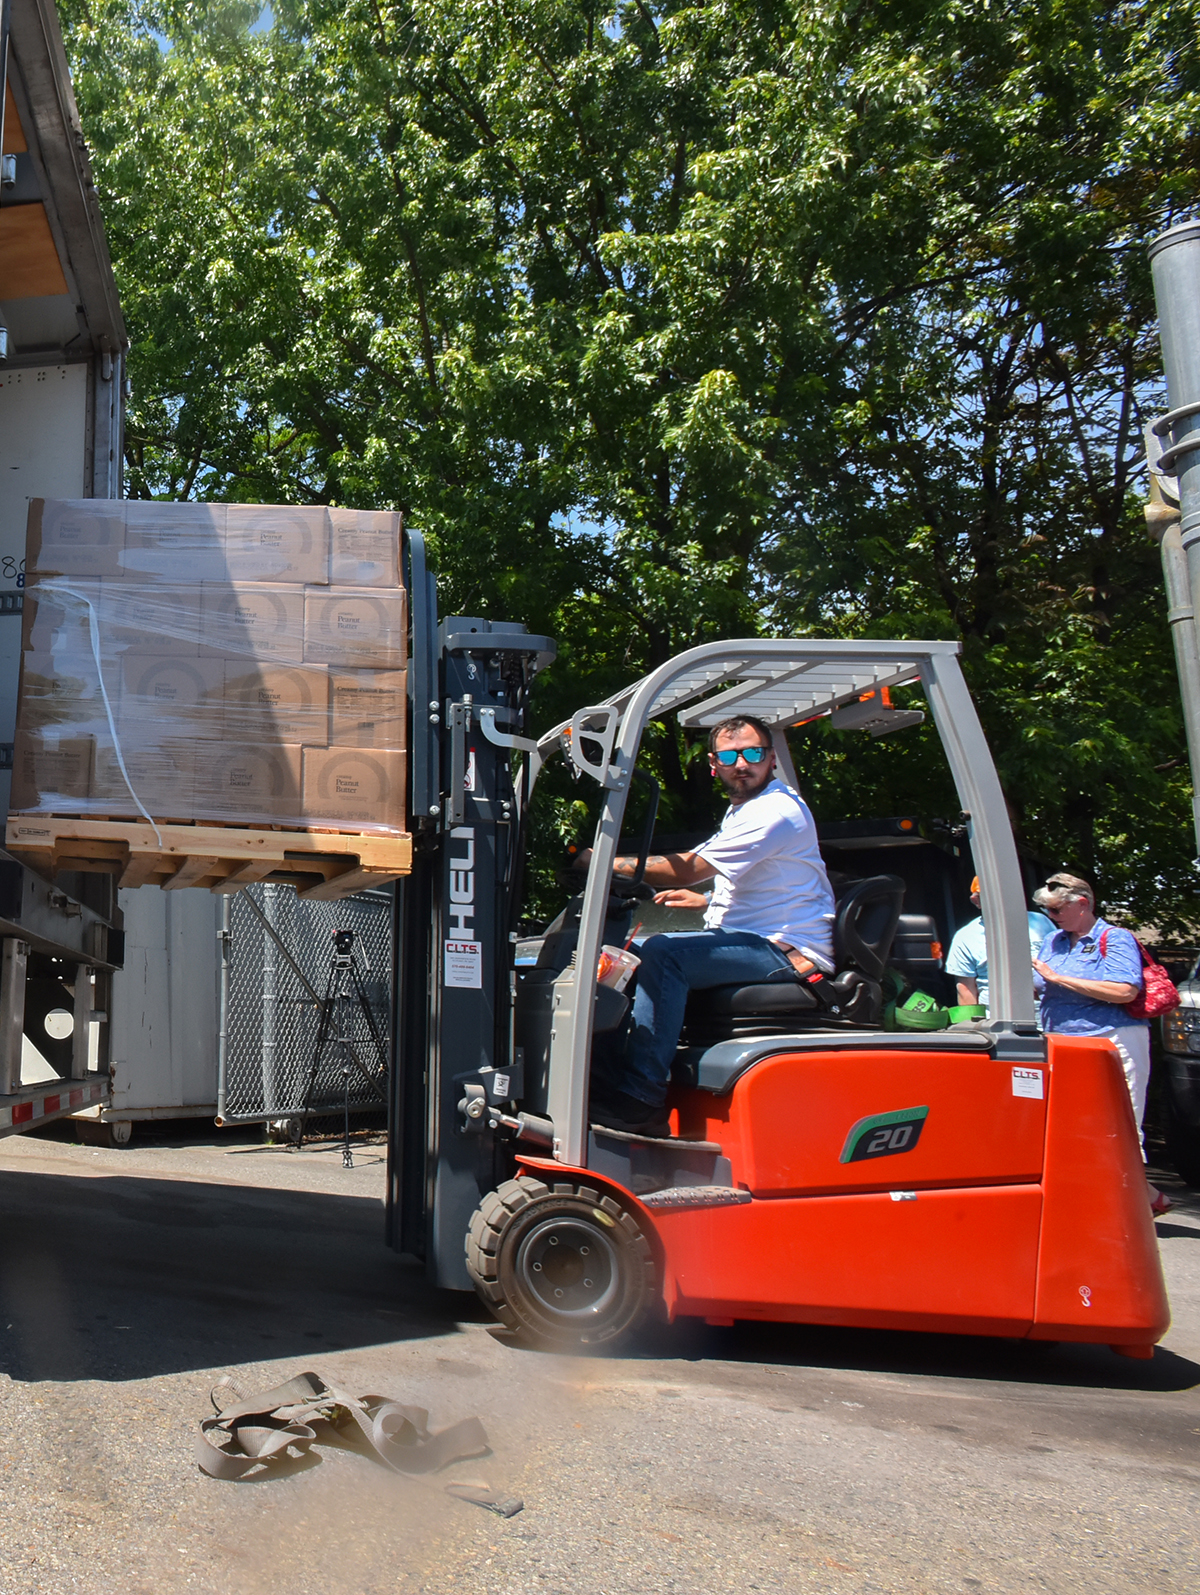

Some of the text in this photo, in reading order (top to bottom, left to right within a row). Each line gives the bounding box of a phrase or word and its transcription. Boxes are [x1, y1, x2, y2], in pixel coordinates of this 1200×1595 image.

[154, 686, 177, 694] Peanut
[258, 692, 281, 700] Peanut
[336, 779, 359, 787] Peanut
[449, 826, 475, 941] HELI
[866, 1126, 913, 1153] 20
